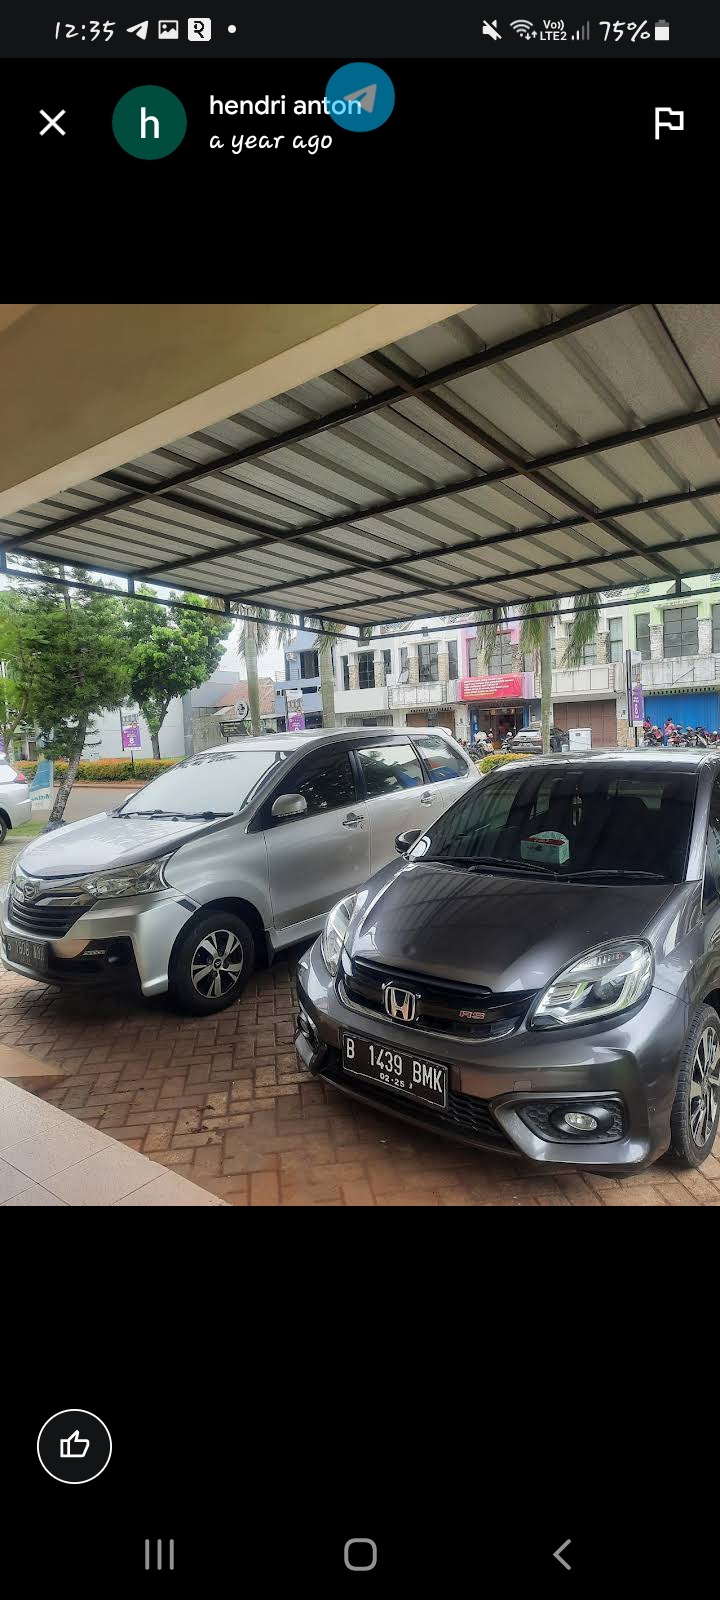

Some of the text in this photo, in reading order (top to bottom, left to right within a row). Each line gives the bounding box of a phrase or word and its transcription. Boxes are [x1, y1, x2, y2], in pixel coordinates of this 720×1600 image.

[458, 1010, 486, 1020] RS
[346, 1037, 443, 1093] B 1439 BMK
